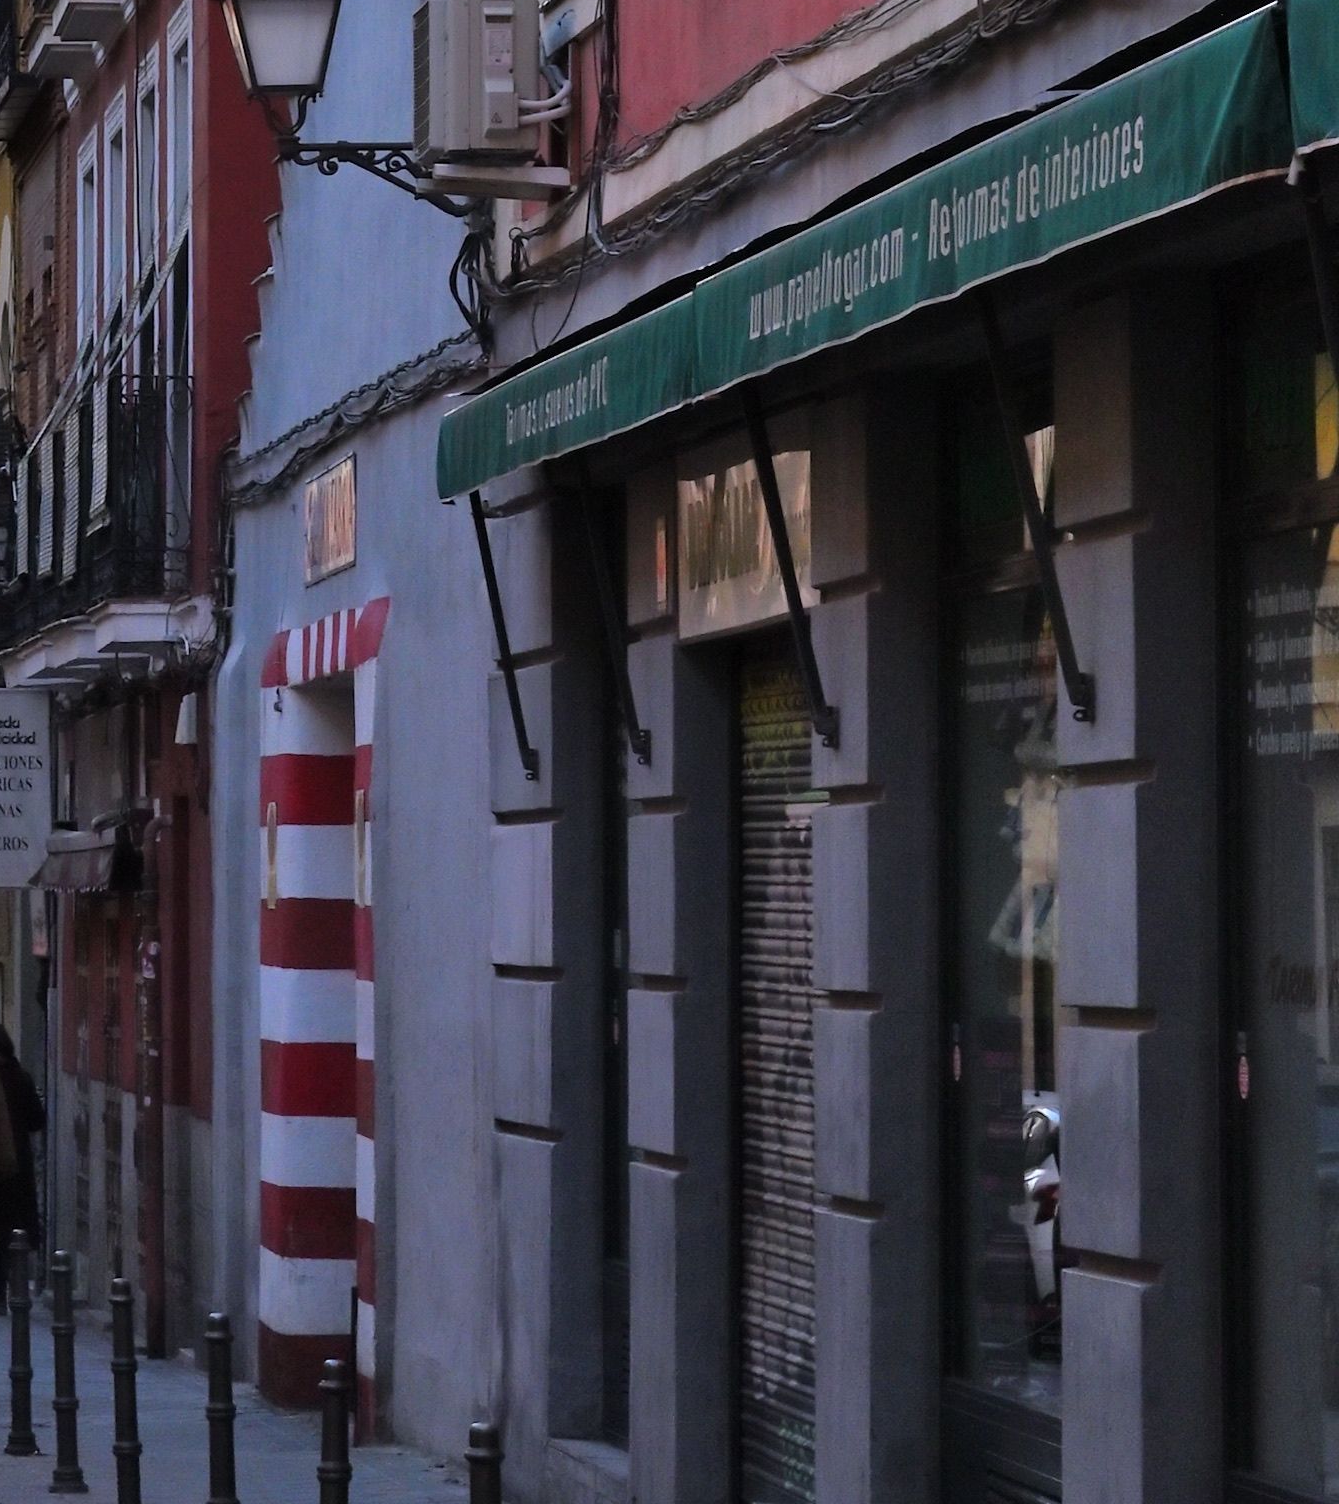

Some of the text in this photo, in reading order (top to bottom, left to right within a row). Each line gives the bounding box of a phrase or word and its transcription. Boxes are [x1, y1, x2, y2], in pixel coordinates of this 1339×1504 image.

[749, 227, 904, 340] www.papelhogar.com
[927, 176, 1010, 265] Reformas
[1015, 155, 1041, 224] de
[1044, 114, 1145, 212] interiores
[588, 355, 609, 412] PVC
